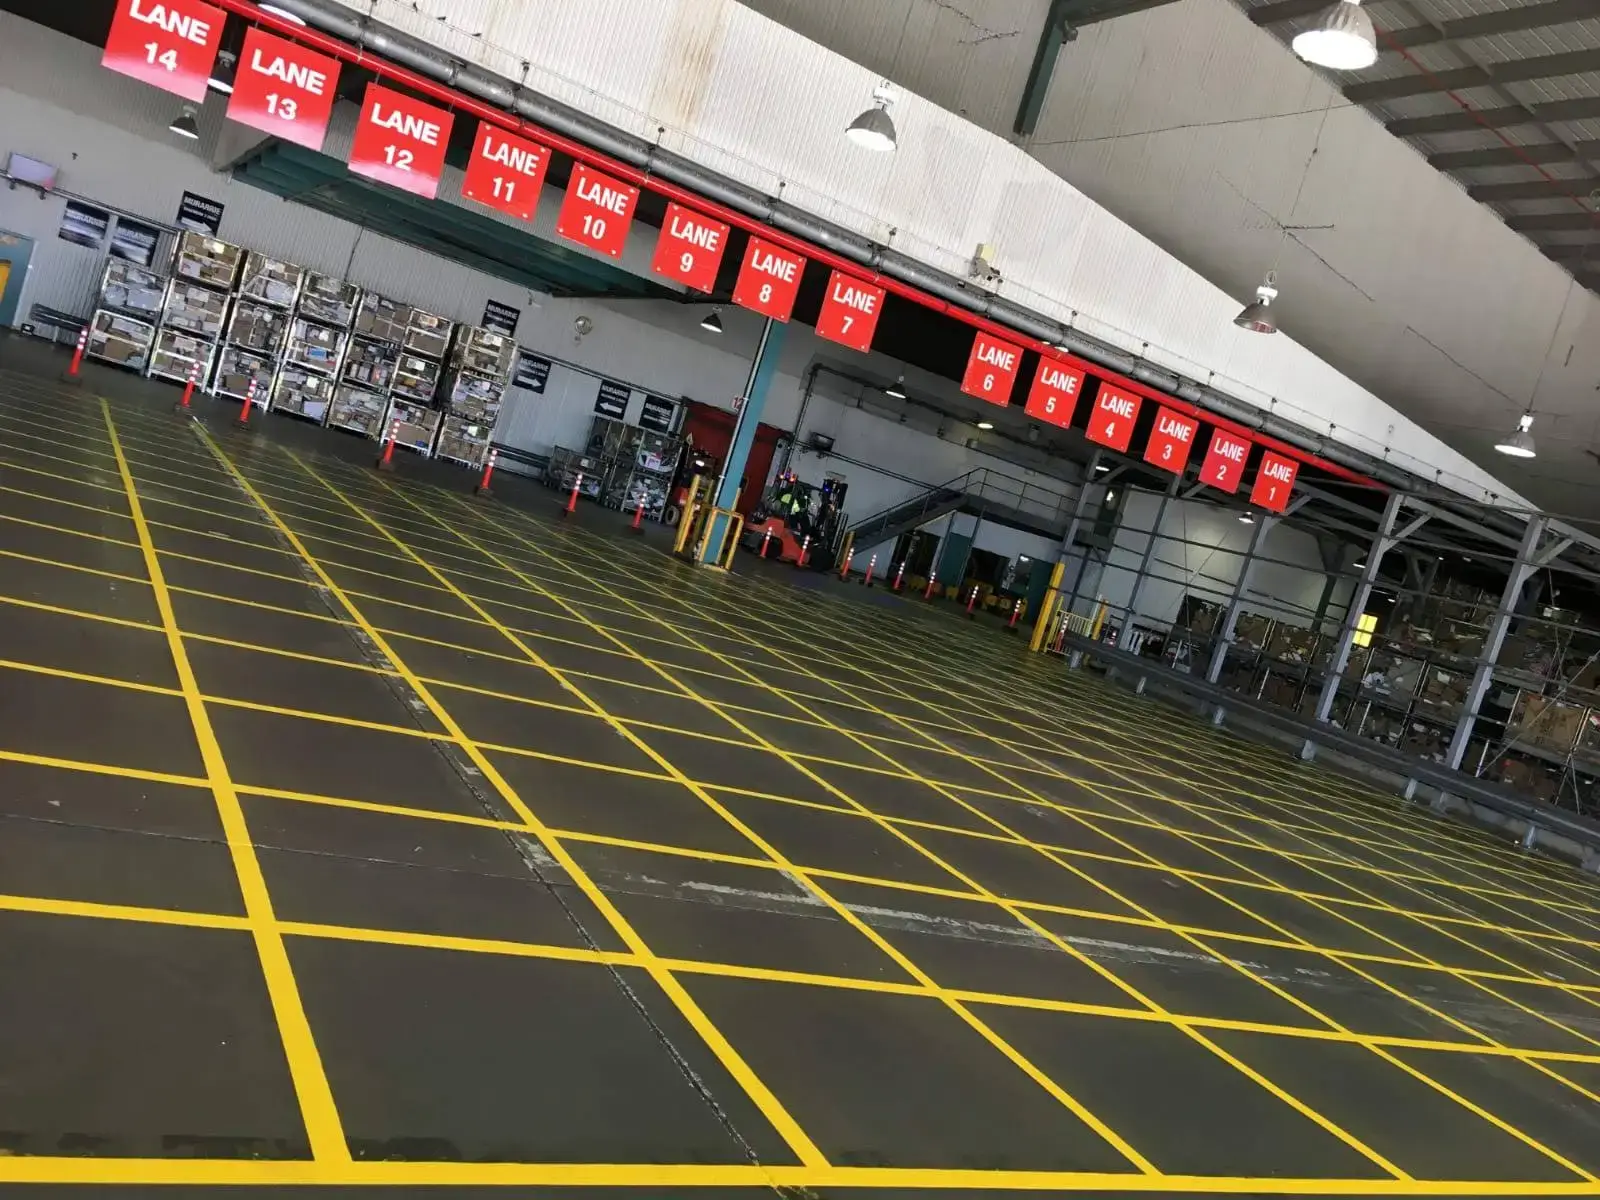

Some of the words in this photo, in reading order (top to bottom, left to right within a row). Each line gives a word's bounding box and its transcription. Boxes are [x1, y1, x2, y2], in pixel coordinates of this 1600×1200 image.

[129, 0, 210, 46] LANE
[145, 42, 177, 72] 14
[251, 48, 326, 96] LANE
[265, 93, 297, 122] 13
[371, 102, 440, 146] LANE
[383, 145, 413, 170] 12
[482, 136, 538, 177] LANE
[492, 176, 515, 202] 11
[575, 176, 628, 216] LANE
[184, 196, 221, 215] MURARRIE
[583, 214, 606, 240] 10
[670, 215, 720, 252] LANE
[679, 252, 694, 273] 9
[751, 248, 797, 284] LANE
[758, 283, 773, 304] 8
[832, 282, 877, 315] LANE
[841, 315, 854, 334] 7
[976, 342, 1016, 372] LANE
[983, 373, 995, 392] 6
[1040, 366, 1078, 395] LANE
[1045, 396, 1057, 414] 5
[1100, 392, 1135, 419] LANE
[1105, 422, 1117, 438] 4
[1158, 416, 1192, 442] LANE
[1162, 444, 1173, 460] 3
[1213, 437, 1245, 463] LANE
[1216, 464, 1227, 481] 2
[1263, 460, 1293, 483] LANE
[1268, 485, 1276, 501] 1
